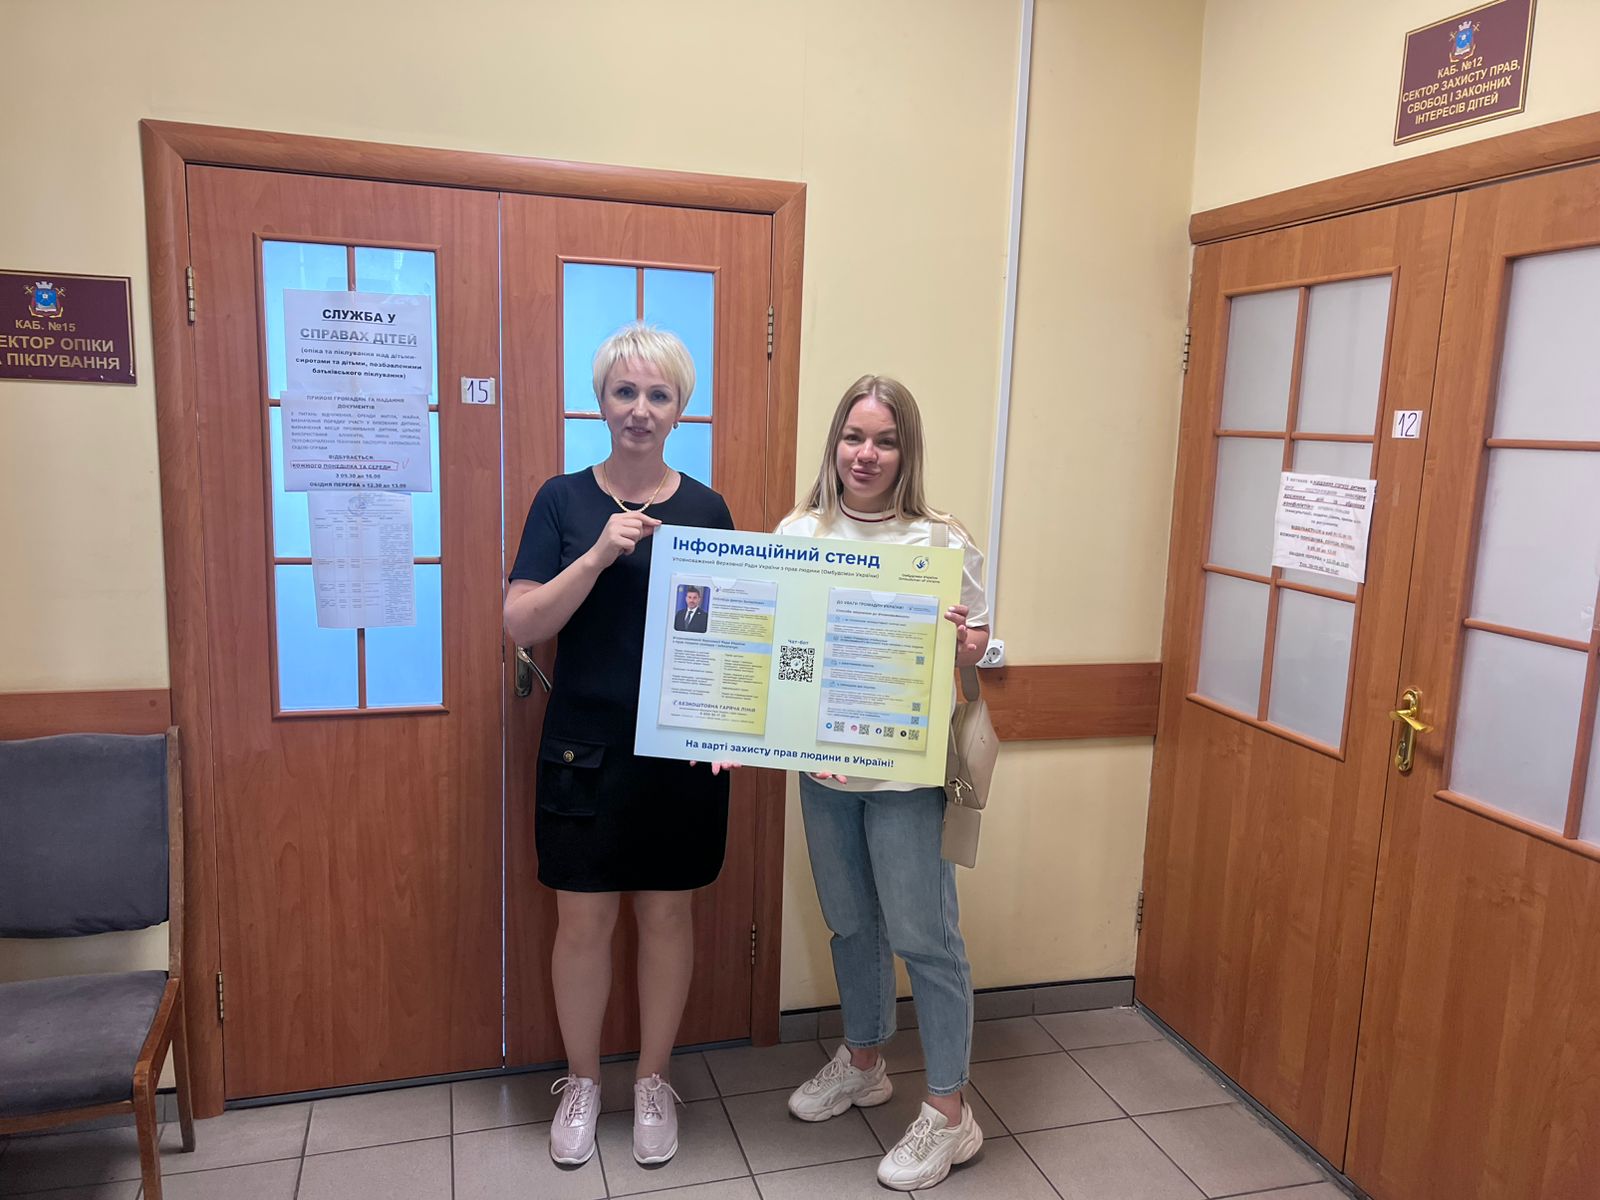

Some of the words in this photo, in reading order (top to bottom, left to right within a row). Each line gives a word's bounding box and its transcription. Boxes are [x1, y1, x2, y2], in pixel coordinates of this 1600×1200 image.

[1437, 65, 1459, 79] КАБ.
[1461, 57, 1482, 71] №12
[1403, 83, 1439, 102] СЕКТОР
[1441, 68, 1488, 91] ЗАХИСТУ
[1490, 59, 1520, 77] ПРАВ,
[1407, 94, 1448, 114] СВОБОД
[1455, 75, 1512, 100] ЗАКОННИХ
[1415, 102, 1466, 125] ІНТЕРЕСІВ
[1467, 92, 1499, 112] ДІТЕЙ
[15, 319, 45, 330] КАБ.
[48, 321, 76, 332] №15
[322, 309, 383, 323] СЛУЖБА
[388, 313, 396, 323] У
[0, 335, 55, 349] ЕКТОР
[60, 338, 114, 352] ОПІКИ
[300, 328, 369, 342] СПРАВАХ
[373, 332, 417, 346] ДІТЕЙ
[7, 353, 120, 370] ПІКЛУВАННЯ
[334, 349, 375, 357] піклування
[312, 368, 362, 376] батьківського
[364, 371, 406, 379] піклування)
[467, 380, 488, 403] 15
[1398, 412, 1418, 437] 12
[672, 536, 820, 562] Інформаційний
[825, 551, 881, 569] стенд
[685, 739, 699, 749] На
[701, 742, 728, 752] варті
[730, 744, 771, 758] захисту
[773, 749, 798, 760] прав
[800, 752, 842, 764] людини
[852, 755, 894, 768] Україні!
